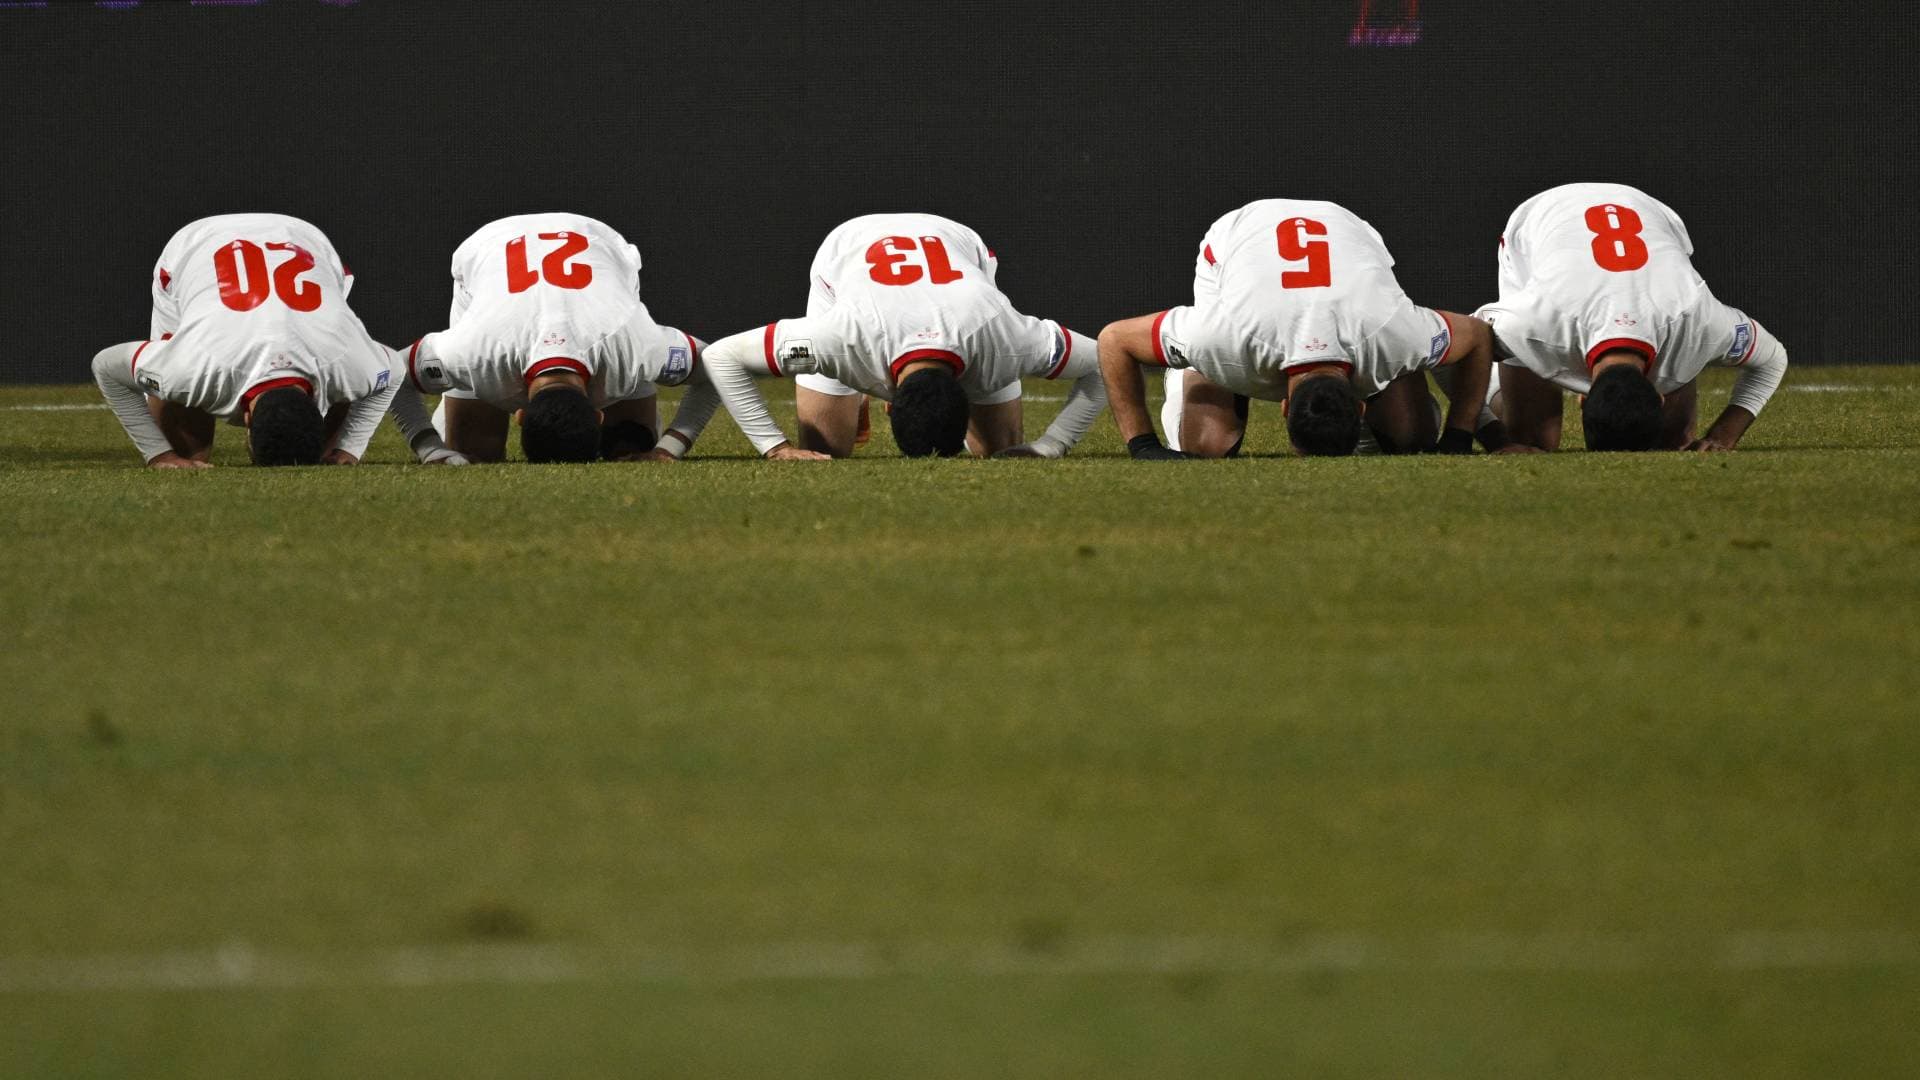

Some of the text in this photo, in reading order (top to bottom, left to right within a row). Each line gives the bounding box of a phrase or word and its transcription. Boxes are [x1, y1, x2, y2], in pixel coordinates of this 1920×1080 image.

[505, 232, 593, 290] 21
[866, 237, 964, 286] 13
[1277, 218, 1331, 288] 5
[1585, 204, 1648, 272] 8
[214, 240, 323, 312] 20
